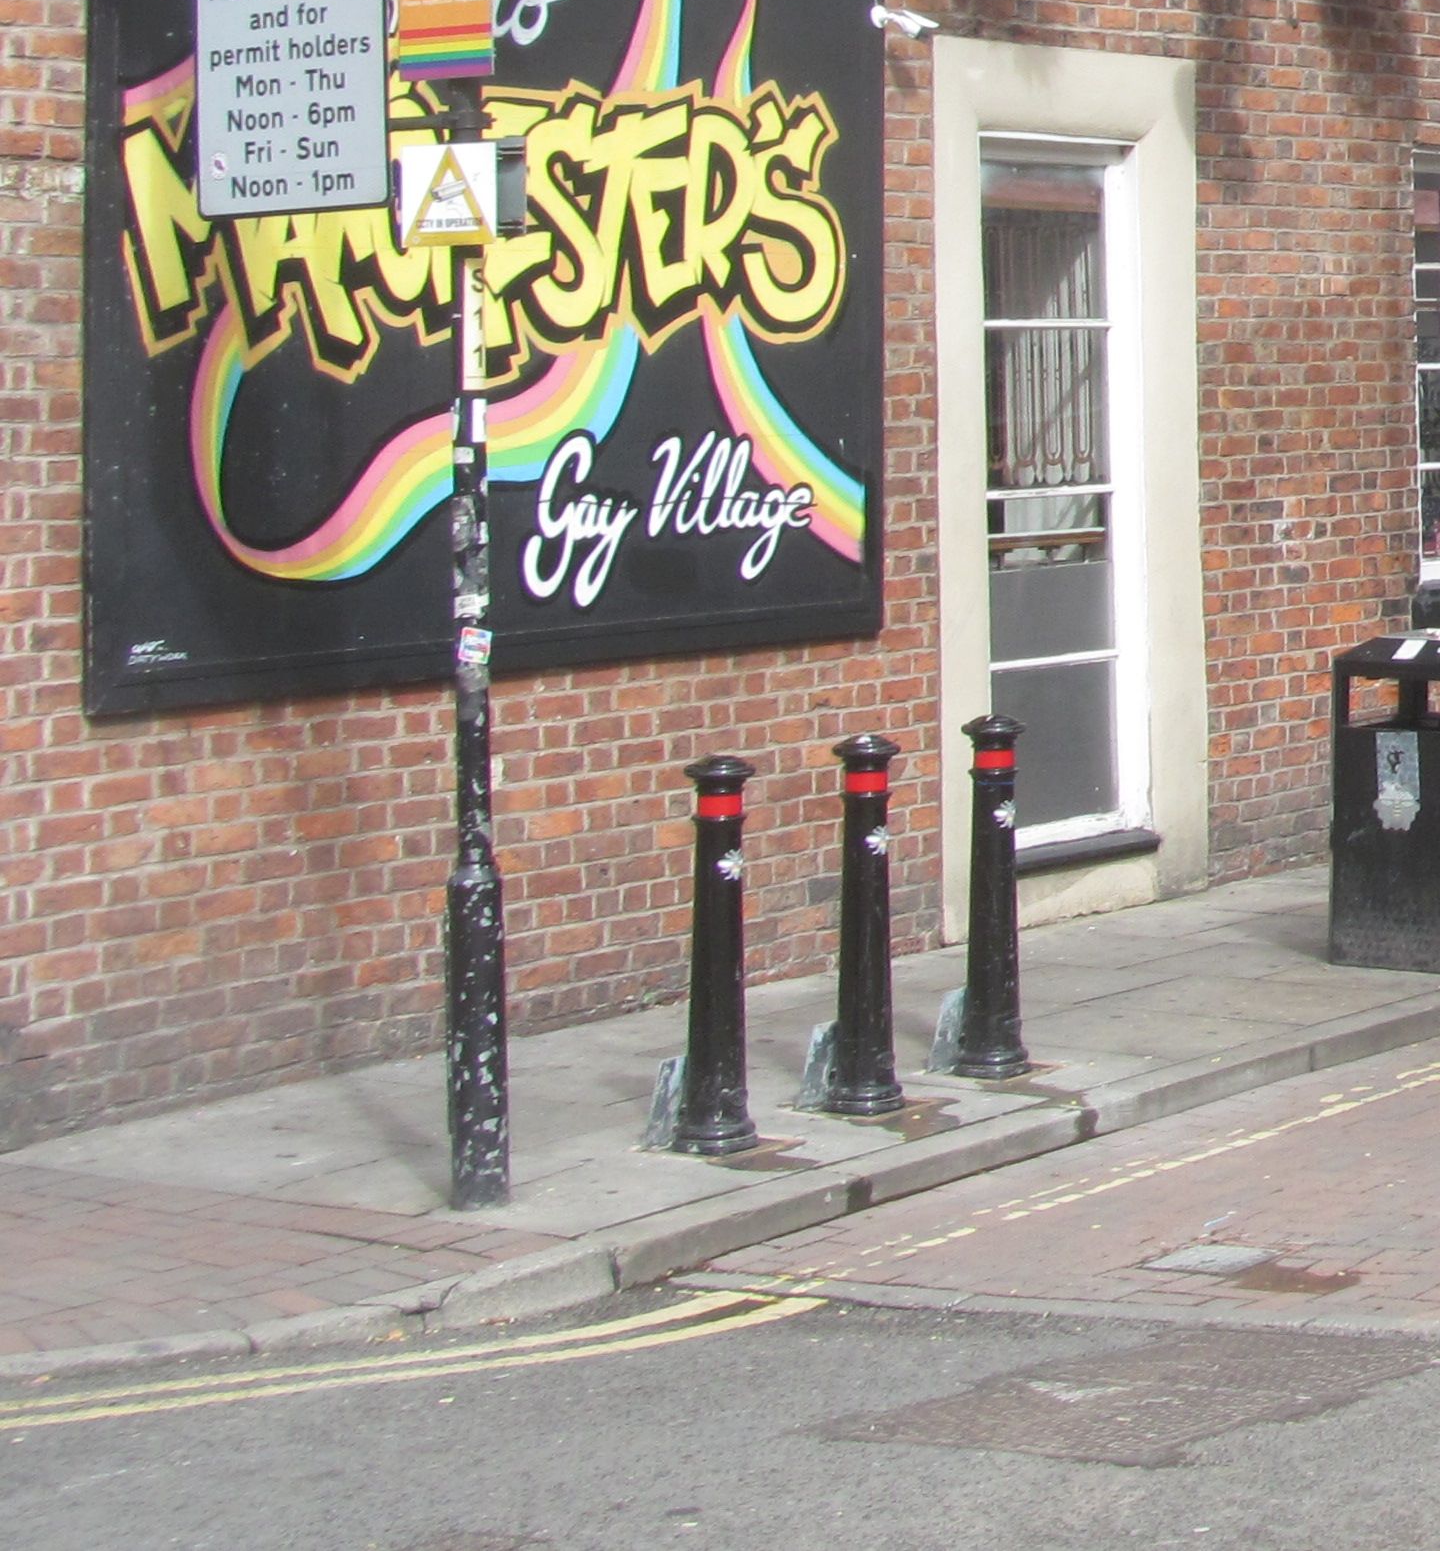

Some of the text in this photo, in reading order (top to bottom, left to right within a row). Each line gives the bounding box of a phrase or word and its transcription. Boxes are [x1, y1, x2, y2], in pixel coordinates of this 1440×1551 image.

[250, 3, 328, 31] and for
[210, 35, 371, 72] permit holders
[235, 75, 281, 98] Mon
[305, 69, 346, 92] Thu
[227, 109, 284, 132] Noon
[308, 103, 356, 127] 6pm
[244, 141, 272, 165] Fri
[296, 137, 340, 160] Sun
[231, 176, 288, 199] Noon
[312, 171, 355, 195] 1pm
[416, 219, 434, 229] CCTV
[523, 430, 814, 607] Gay Village
